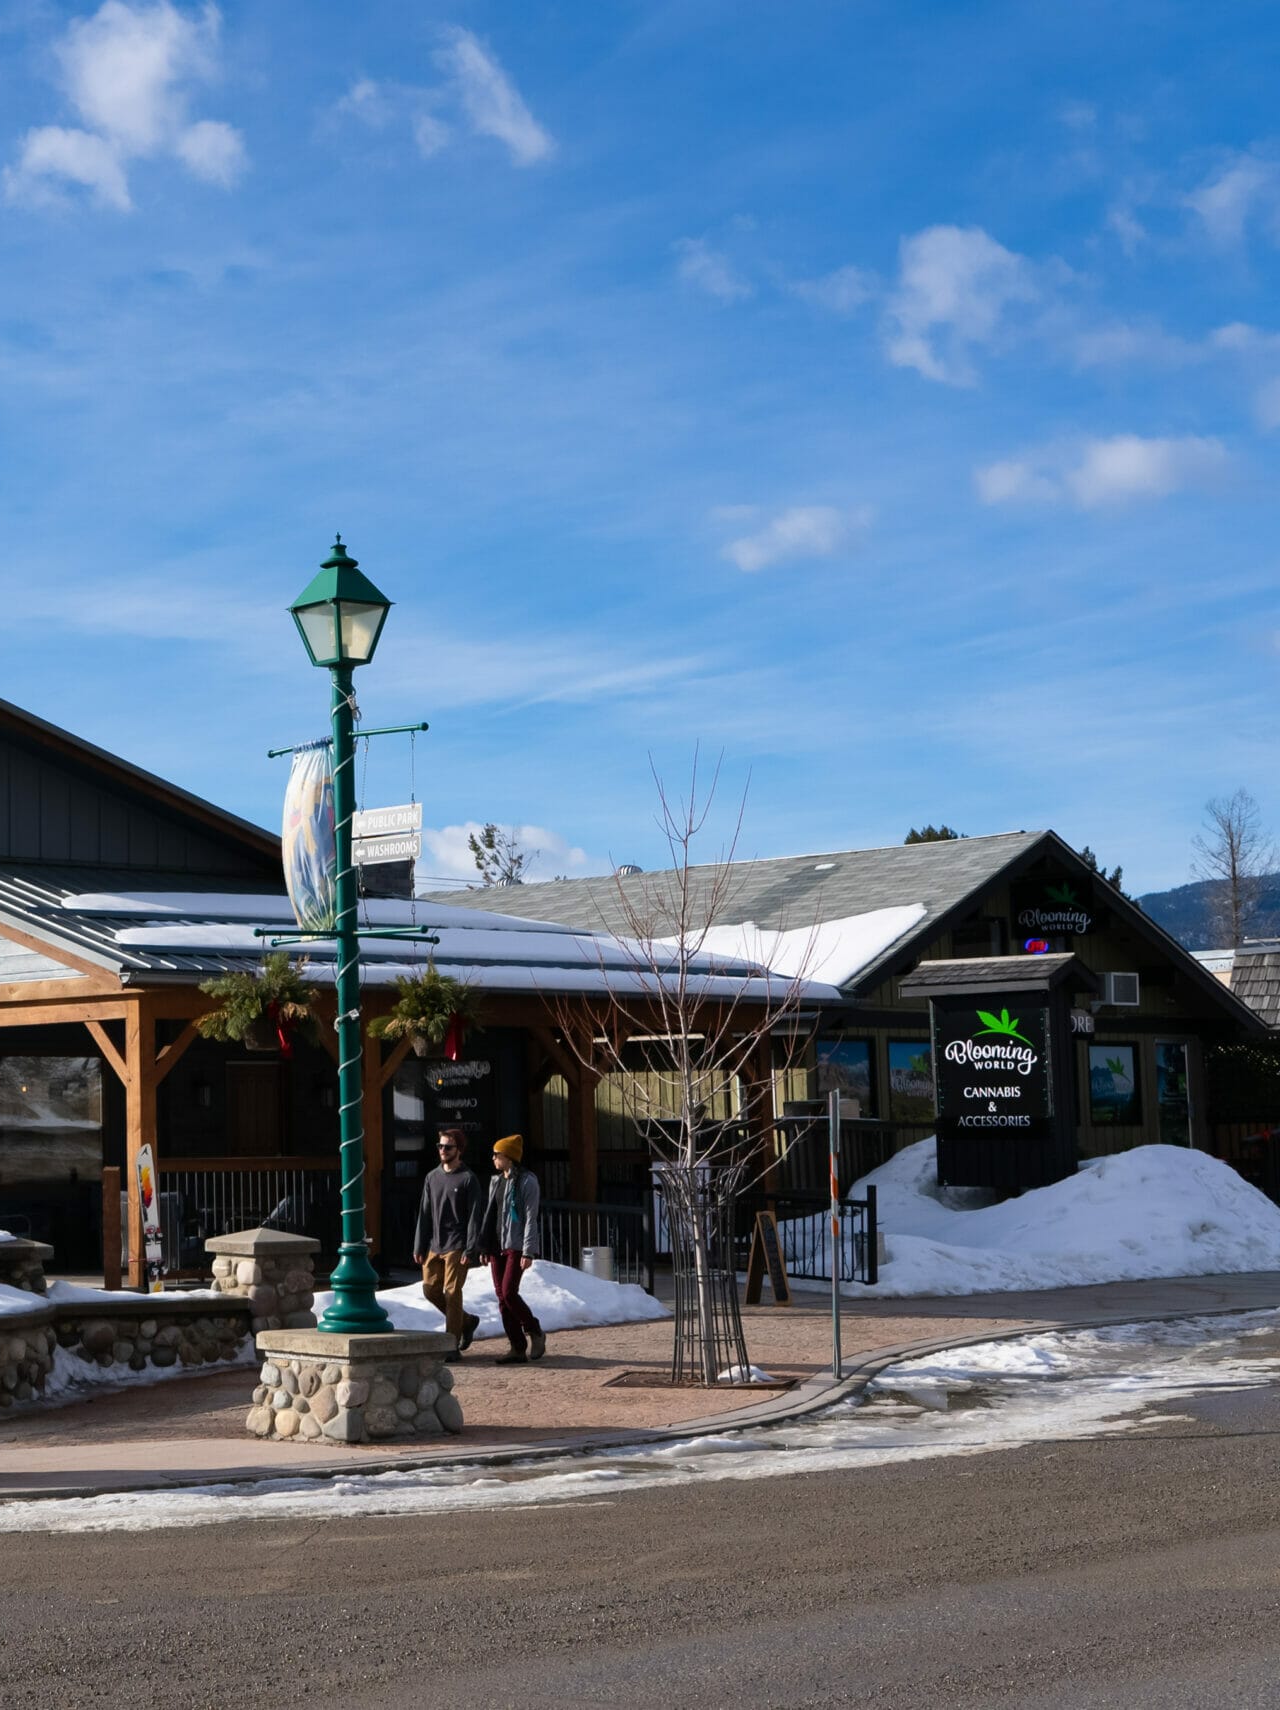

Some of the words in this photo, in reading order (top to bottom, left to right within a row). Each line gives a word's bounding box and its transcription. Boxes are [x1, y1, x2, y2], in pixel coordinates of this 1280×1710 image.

[368, 814, 396, 829] PUBLIC
[397, 811, 419, 825] PARK
[367, 840, 418, 858] WASHROOMS
[1018, 907, 1091, 934] Blooming
[1041, 923, 1073, 931] WORLD
[945, 1039, 1037, 1075] Blooming
[974, 1060, 1015, 1070] WORLD
[963, 1086, 1021, 1098] CANNABIS
[988, 1102, 997, 1112] &
[957, 1115, 1030, 1127] ACCESSORIES
